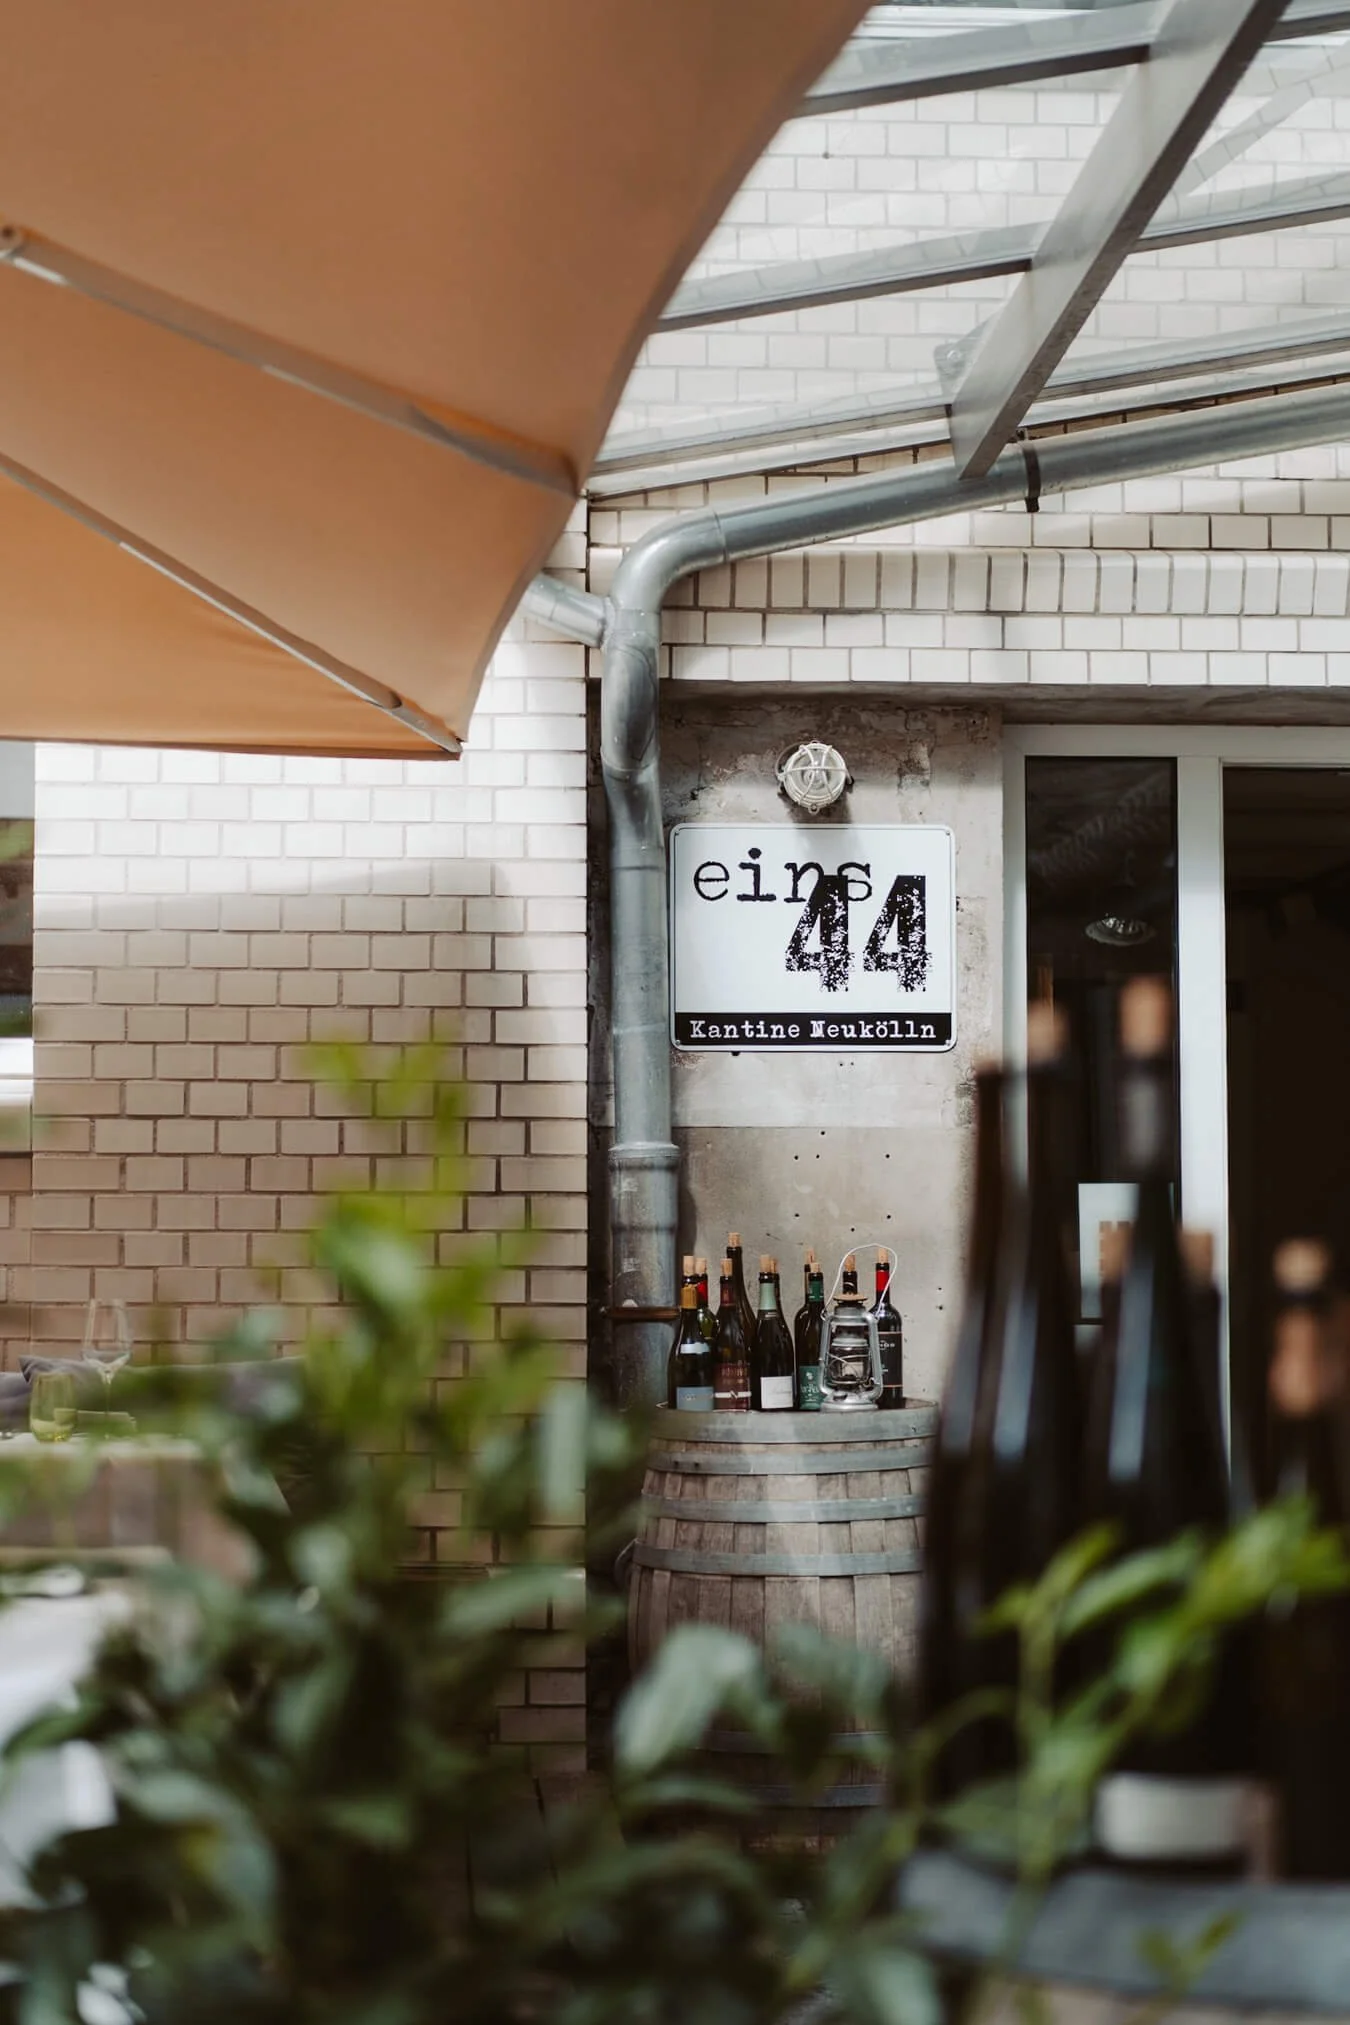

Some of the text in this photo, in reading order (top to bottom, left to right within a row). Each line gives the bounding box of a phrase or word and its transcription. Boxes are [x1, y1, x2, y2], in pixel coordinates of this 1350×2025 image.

[693, 847, 873, 902] eins
[785, 874, 931, 992] 44
[689, 1019, 937, 1039] Kantine Neukölln
